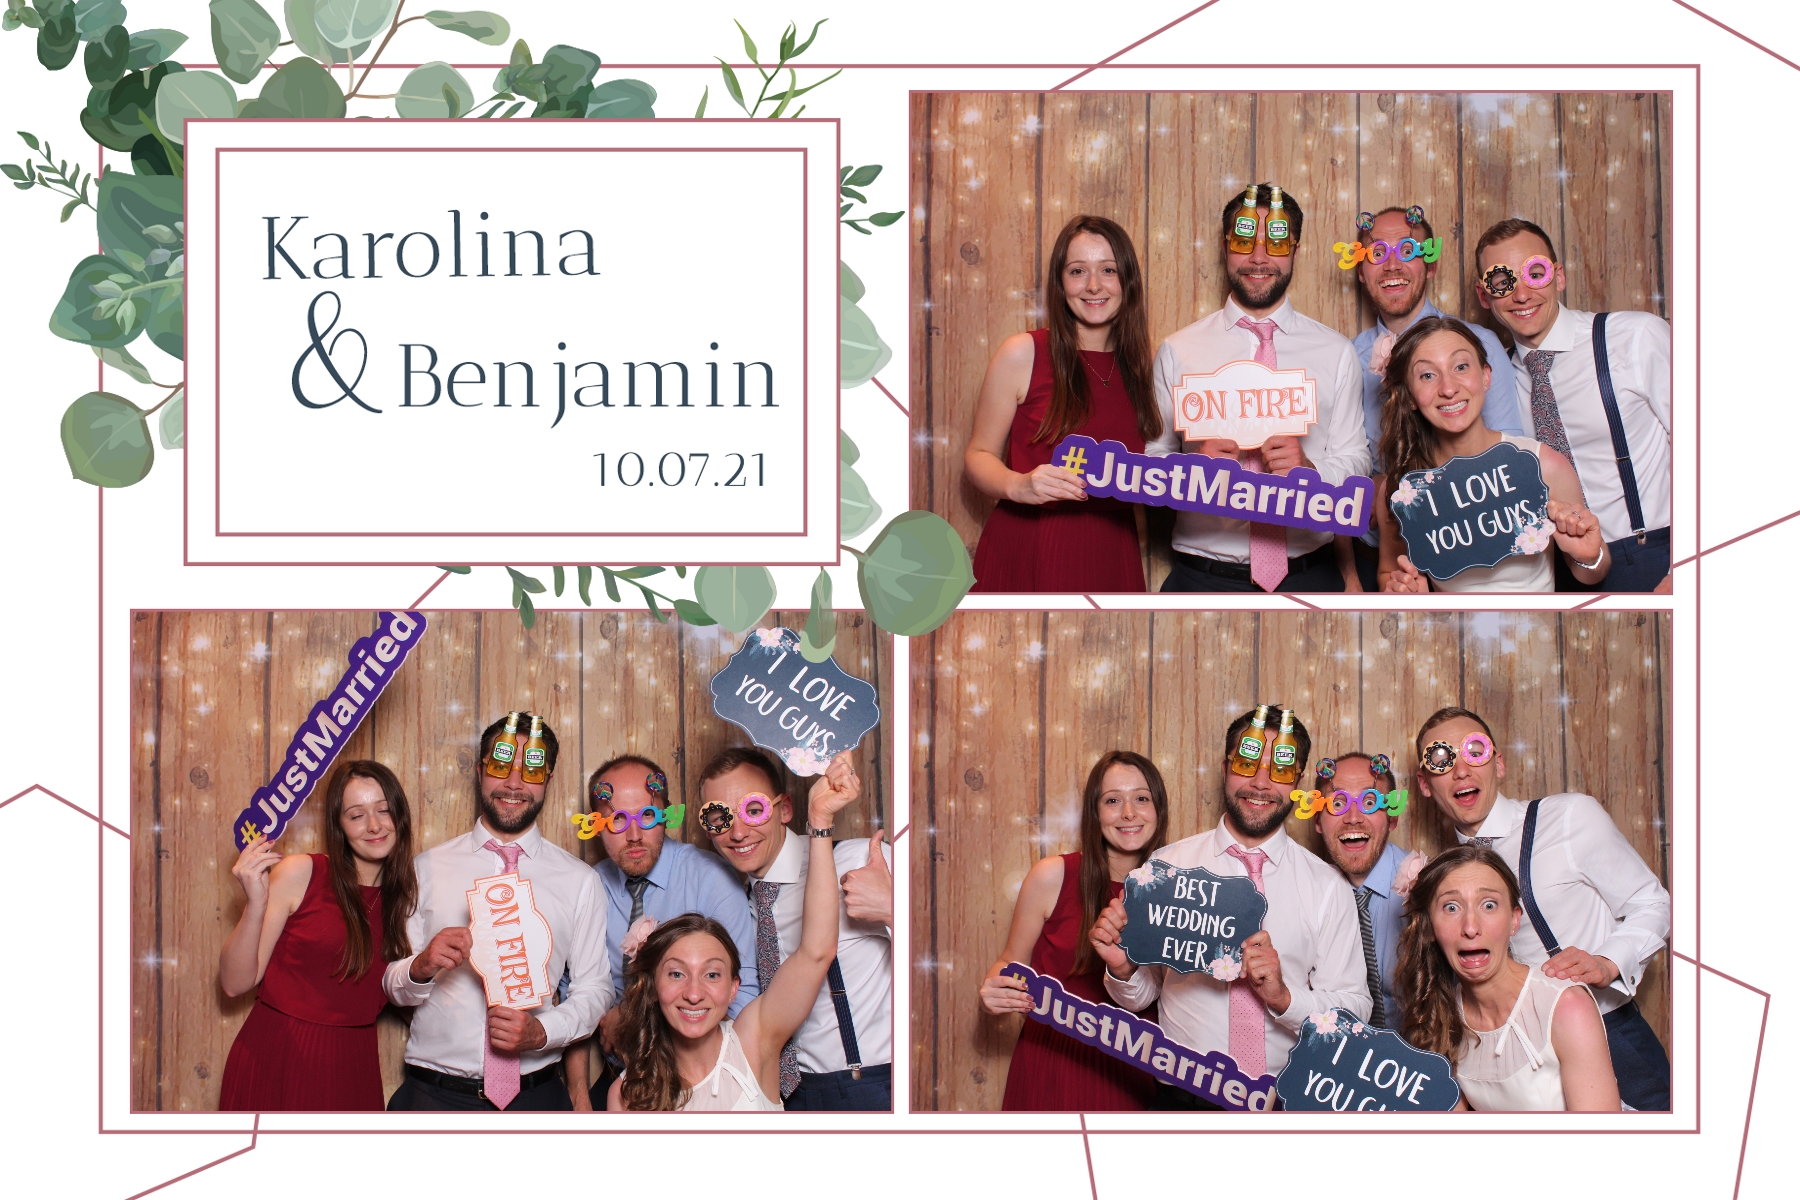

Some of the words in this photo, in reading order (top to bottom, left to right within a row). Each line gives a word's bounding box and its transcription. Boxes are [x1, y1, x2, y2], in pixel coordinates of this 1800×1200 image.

[1181, 389, 1228, 423] ON
[1235, 386, 1308, 419] FIRE
[1060, 446, 1365, 527] #JustMarried
[1426, 489, 1438, 516] I
[1450, 464, 1516, 508] LOVE
[1425, 519, 1473, 554] YOU
[1477, 499, 1538, 538] GUYS
[767, 651, 787, 675] I
[788, 666, 856, 721] LOVE
[240, 611, 418, 846] #JustMarried
[735, 674, 783, 716] YOU
[778, 706, 836, 756] GUYS
[484, 883, 521, 928] ON
[1174, 875, 1221, 907] BEST
[1148, 902, 1236, 939] WEDDING
[495, 932, 535, 1003] FIRE
[1161, 936, 1208, 970] EVER
[1013, 973, 1276, 1111] JustMarried
[1304, 1069, 1355, 1111] YOU
[1331, 1036, 1347, 1065] I
[1357, 1048, 1431, 1105] LOVE
